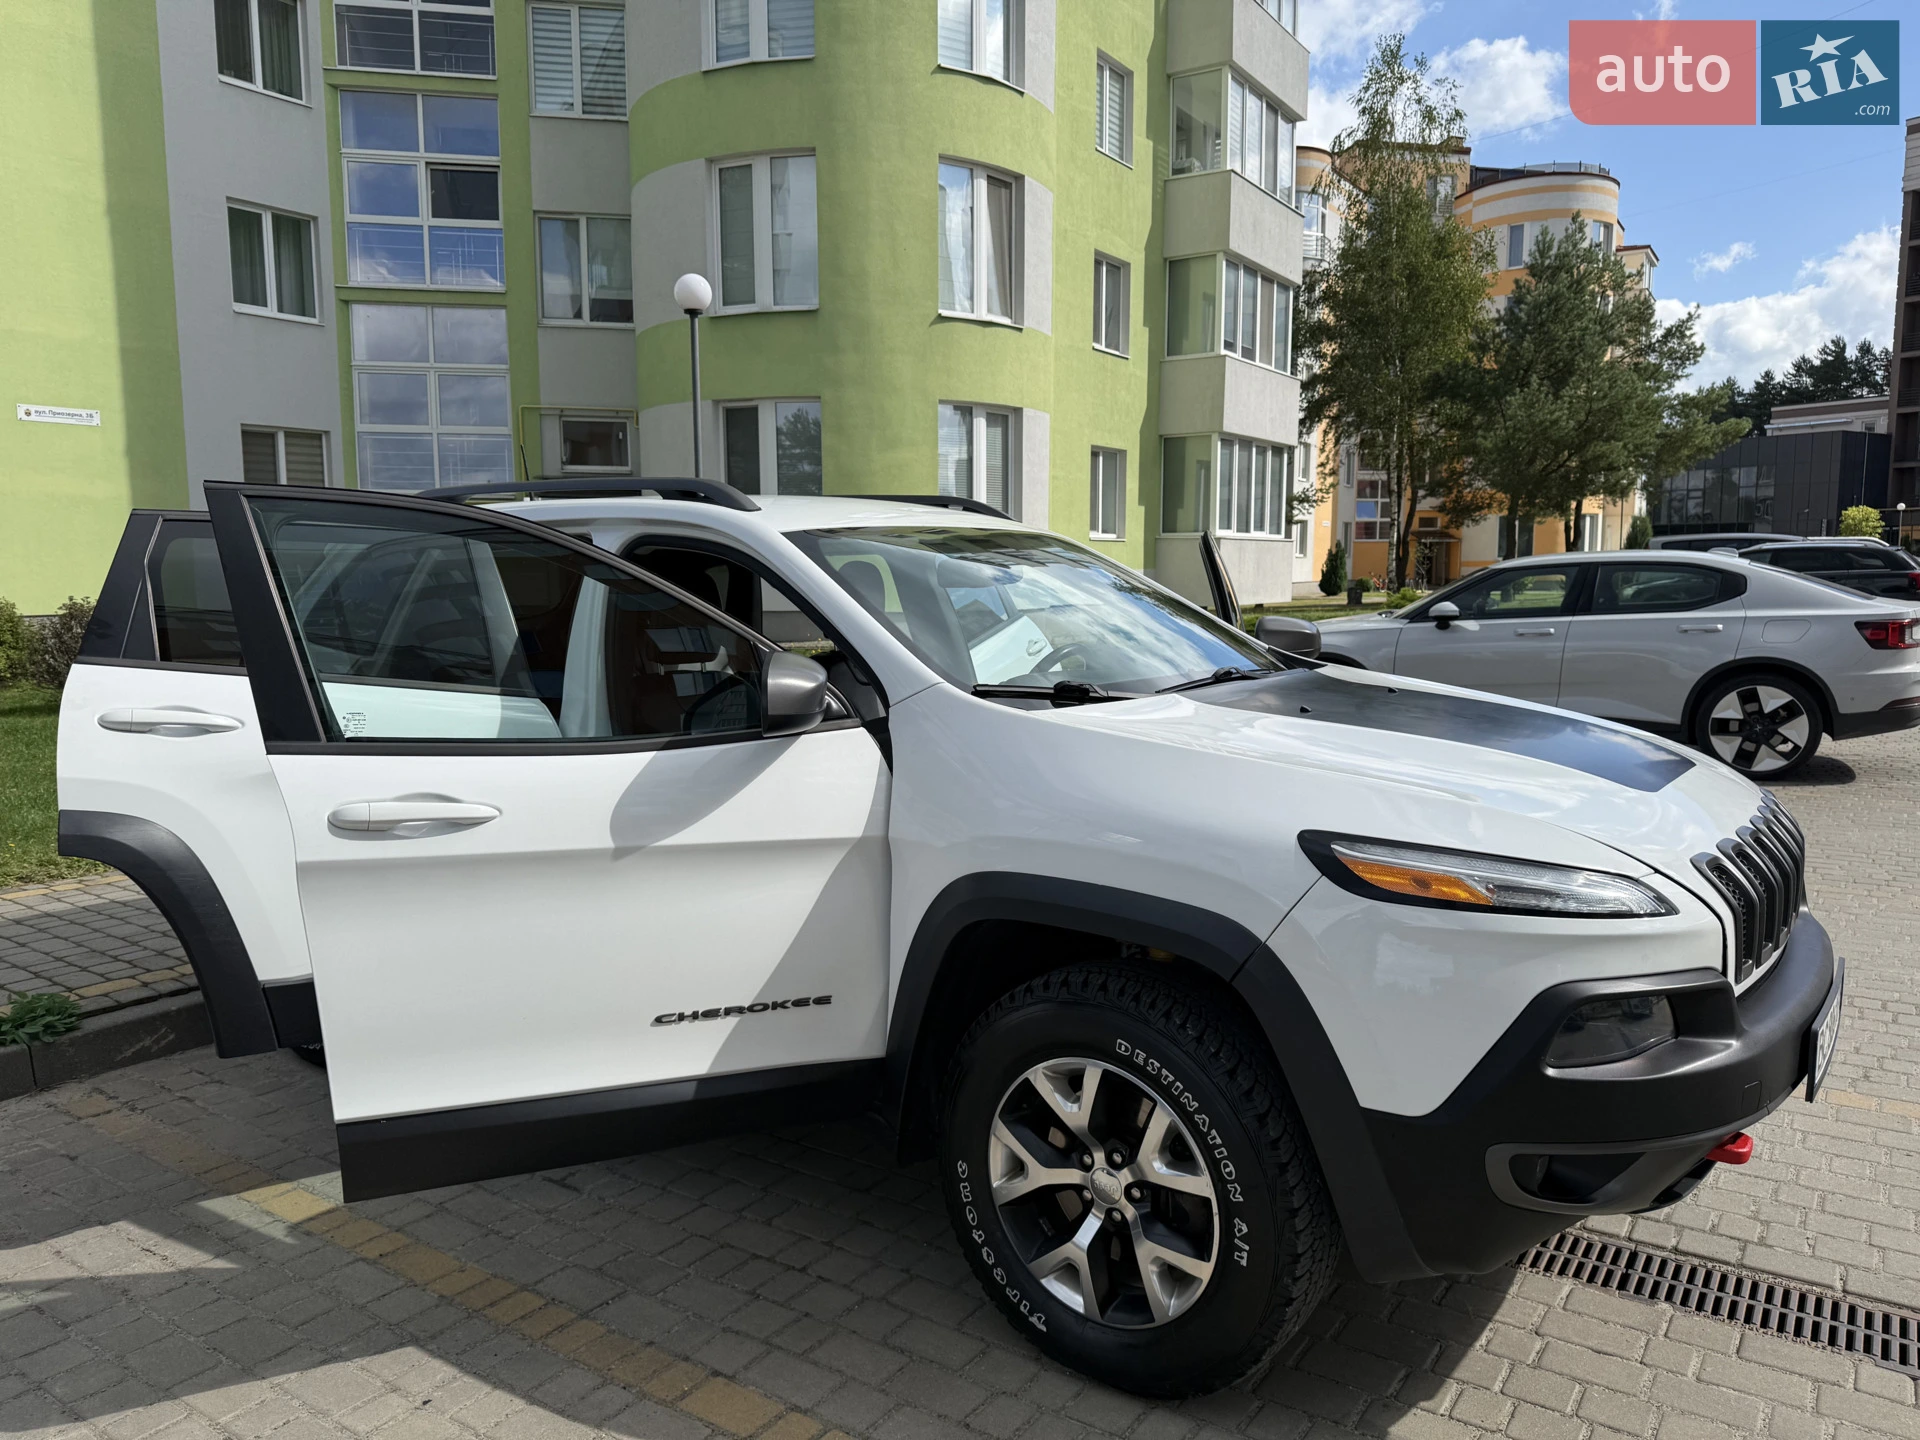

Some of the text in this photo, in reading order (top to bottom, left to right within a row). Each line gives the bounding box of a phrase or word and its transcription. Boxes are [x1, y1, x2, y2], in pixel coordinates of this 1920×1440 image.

[34, 408, 47, 416] вул.
[654, 995, 833, 1024] CHEROKEE
[1115, 1039, 1250, 1267] DESTINATION A/T
